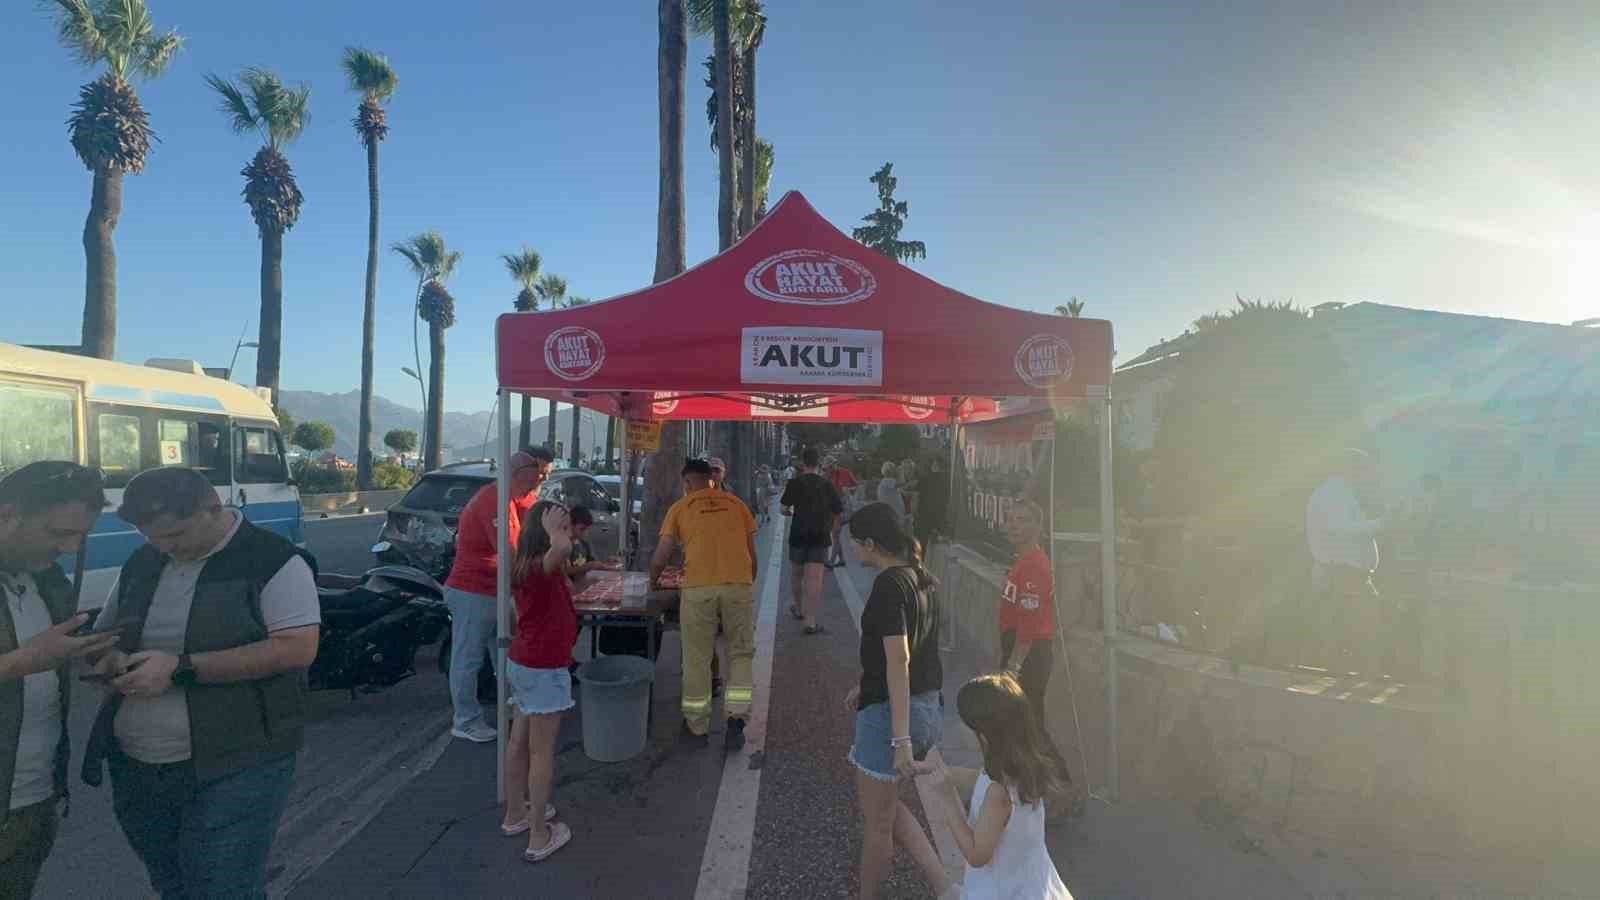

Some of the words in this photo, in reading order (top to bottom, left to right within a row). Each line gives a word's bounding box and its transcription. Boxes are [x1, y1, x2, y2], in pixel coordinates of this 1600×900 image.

[776, 262, 837, 276] AKUT
[776, 275, 843, 288] HAYAT
[558, 335, 589, 350] AKUT
[759, 344, 865, 369] AKUT
[167, 446, 177, 460] 3
